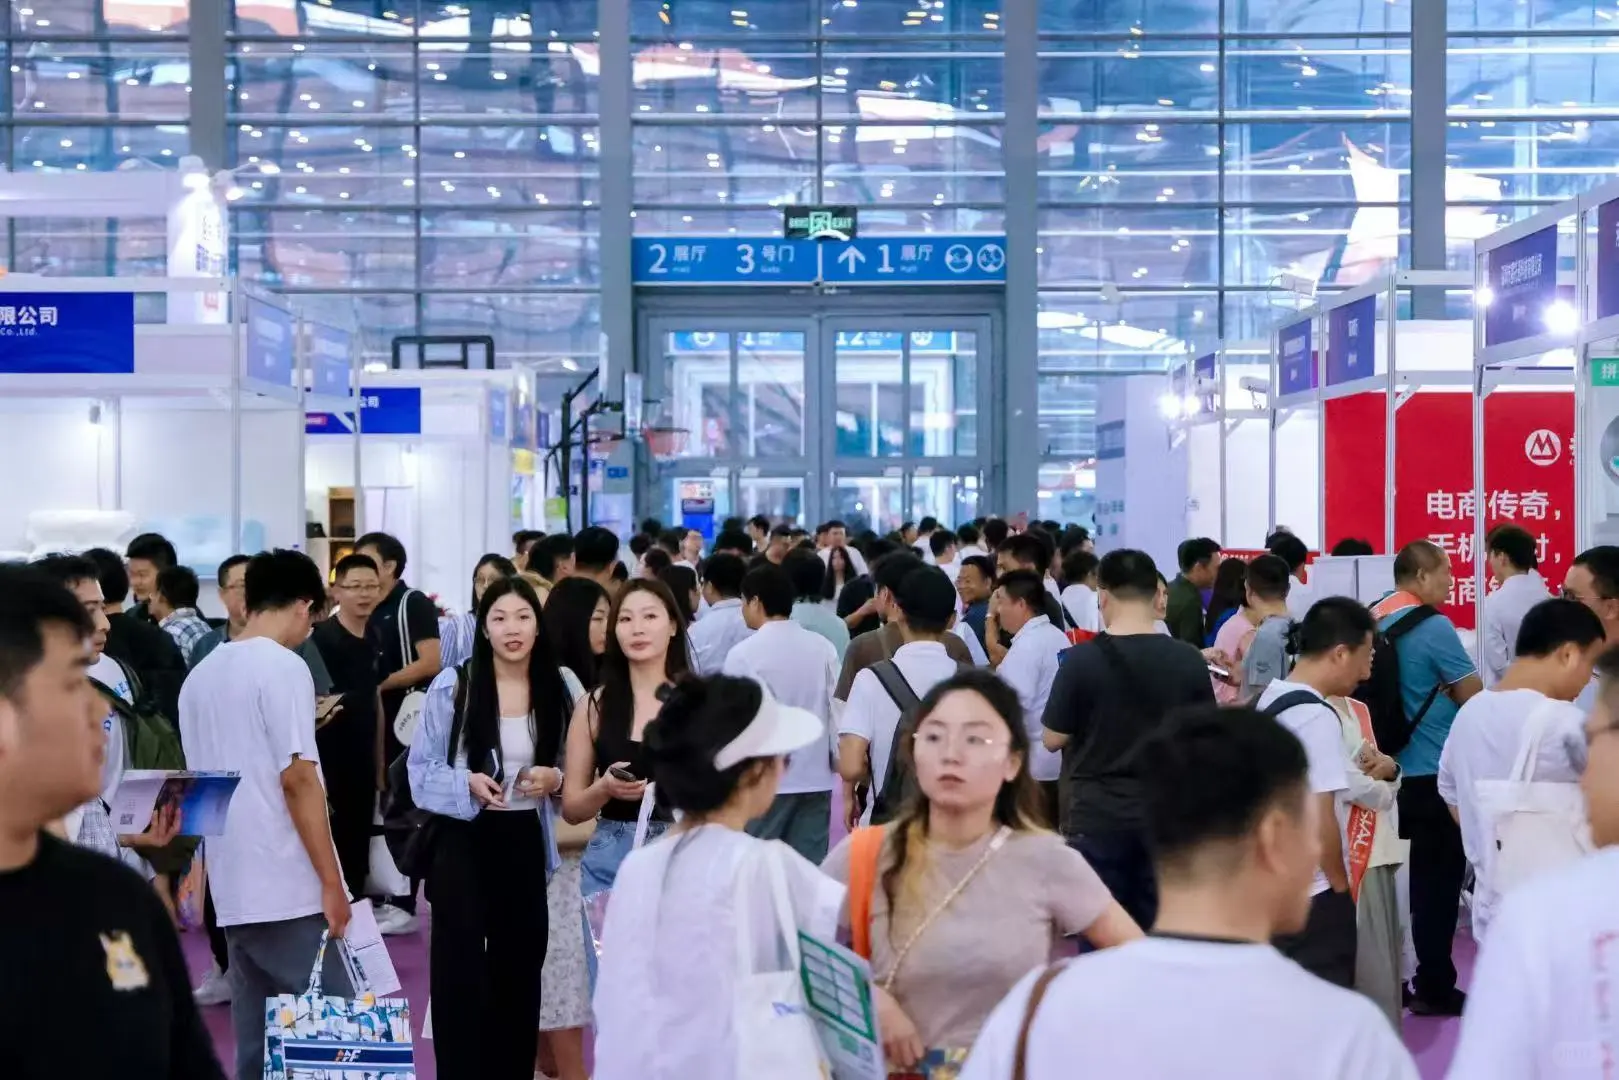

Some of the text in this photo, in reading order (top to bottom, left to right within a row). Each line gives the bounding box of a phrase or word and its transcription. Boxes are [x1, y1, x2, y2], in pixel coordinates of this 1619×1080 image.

[648, 243, 668, 274] 2
[736, 243, 756, 274] 3
[761, 244, 795, 262] 号门
[877, 244, 895, 273] 1
